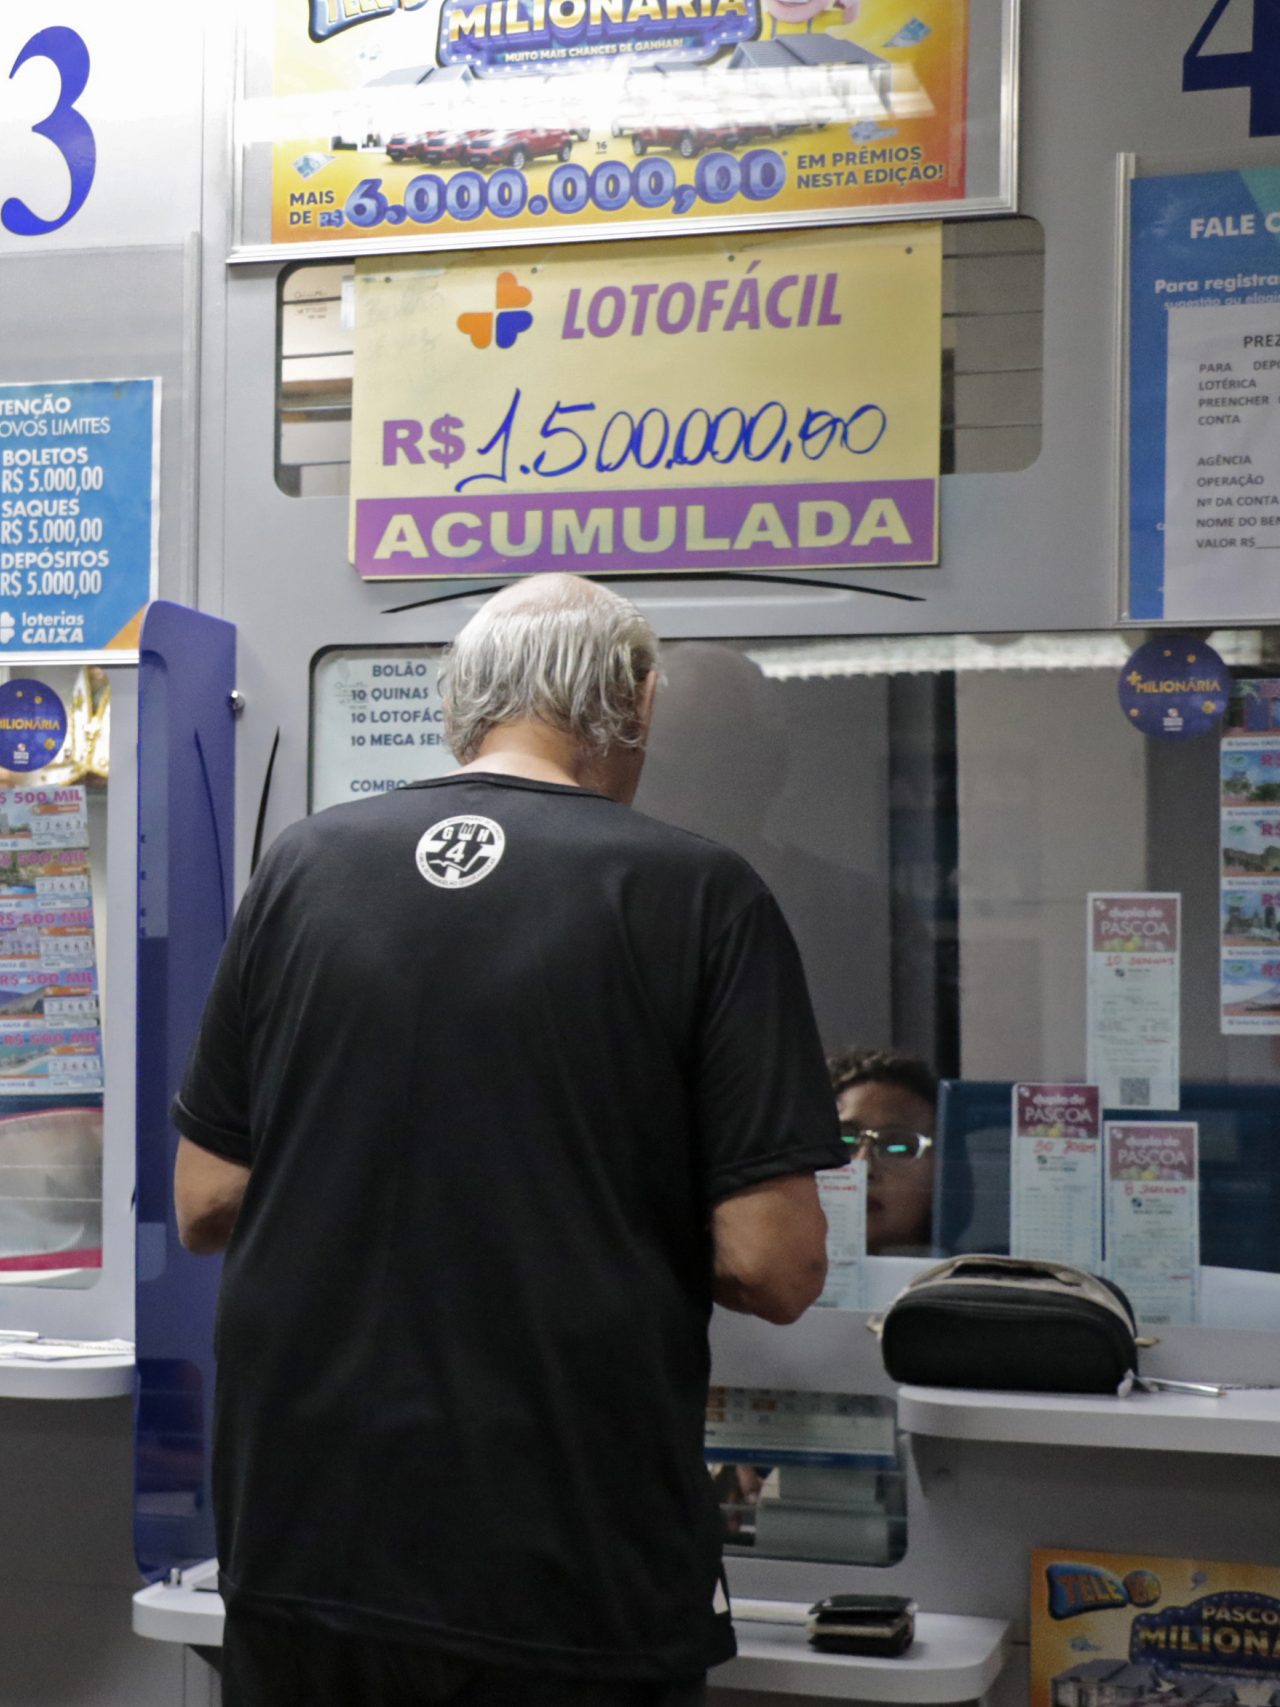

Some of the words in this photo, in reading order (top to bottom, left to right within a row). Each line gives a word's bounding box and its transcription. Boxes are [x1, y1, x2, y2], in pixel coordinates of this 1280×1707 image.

[505, 50, 539, 63] MUITO
[540, 49, 567, 60] MAIS
[569, 45, 617, 58] CHANCES
[636, 39, 684, 52] GANHAR!
[1182, 0, 1280, 137] 4
[1, 26, 96, 236] 3
[797, 154, 826, 170] EM
[832, 145, 923, 167] PRÊMIOS
[797, 172, 857, 190] NESTA
[863, 162, 943, 187] EDIÇÃO!
[289, 191, 335, 206] MAIS
[289, 211, 312, 225] DE
[1190, 214, 1255, 239] FALE
[1154, 278, 1198, 294] Para
[561, 260, 843, 341] LOTOFÁCIL
[1199, 363, 1232, 373] PARA
[1199, 377, 1257, 391] LOTÉRICA
[1198, 395, 1269, 408] PREENCHER
[52, 417, 111, 435] LIMITES
[1198, 415, 1241, 426] CONTA
[382, 414, 466, 469] R$
[3, 447, 88, 466] BOLETOS
[1197, 453, 1252, 467] AGÊNCIA
[2, 469, 23, 494] R$
[28, 466, 103, 495] 5.000,00
[1196, 474, 1265, 487] OPERAÇÃO
[2, 499, 80, 518] SAQUES
[1215, 497, 1234, 507] DA
[1236, 496, 1279, 506] CONTA
[373, 498, 913, 560] ACUMULADA
[1196, 517, 1234, 528] NOME
[1238, 516, 1257, 527] DO
[1, 520, 22, 545] R$
[28, 518, 103, 547] 5.000,00
[1196, 538, 1236, 549] VALOR
[1, 548, 109, 570] DEPÓSITOS
[0, 572, 22, 597] R$
[27, 570, 102, 599] 5.000,00
[22, 611, 84, 626] loterias
[22, 628, 84, 643] CAIXA
[373, 662, 427, 677] BOLÃO
[352, 690, 366, 700] 10
[371, 687, 428, 702] QUINAS
[352, 713, 366, 723] 10
[352, 736, 366, 746] 10
[370, 734, 414, 746] MEGA
[350, 780, 408, 792] COMBO
[15, 791, 48, 804] 500
[54, 789, 82, 802] MIL
[445, 841, 467, 863] 4
